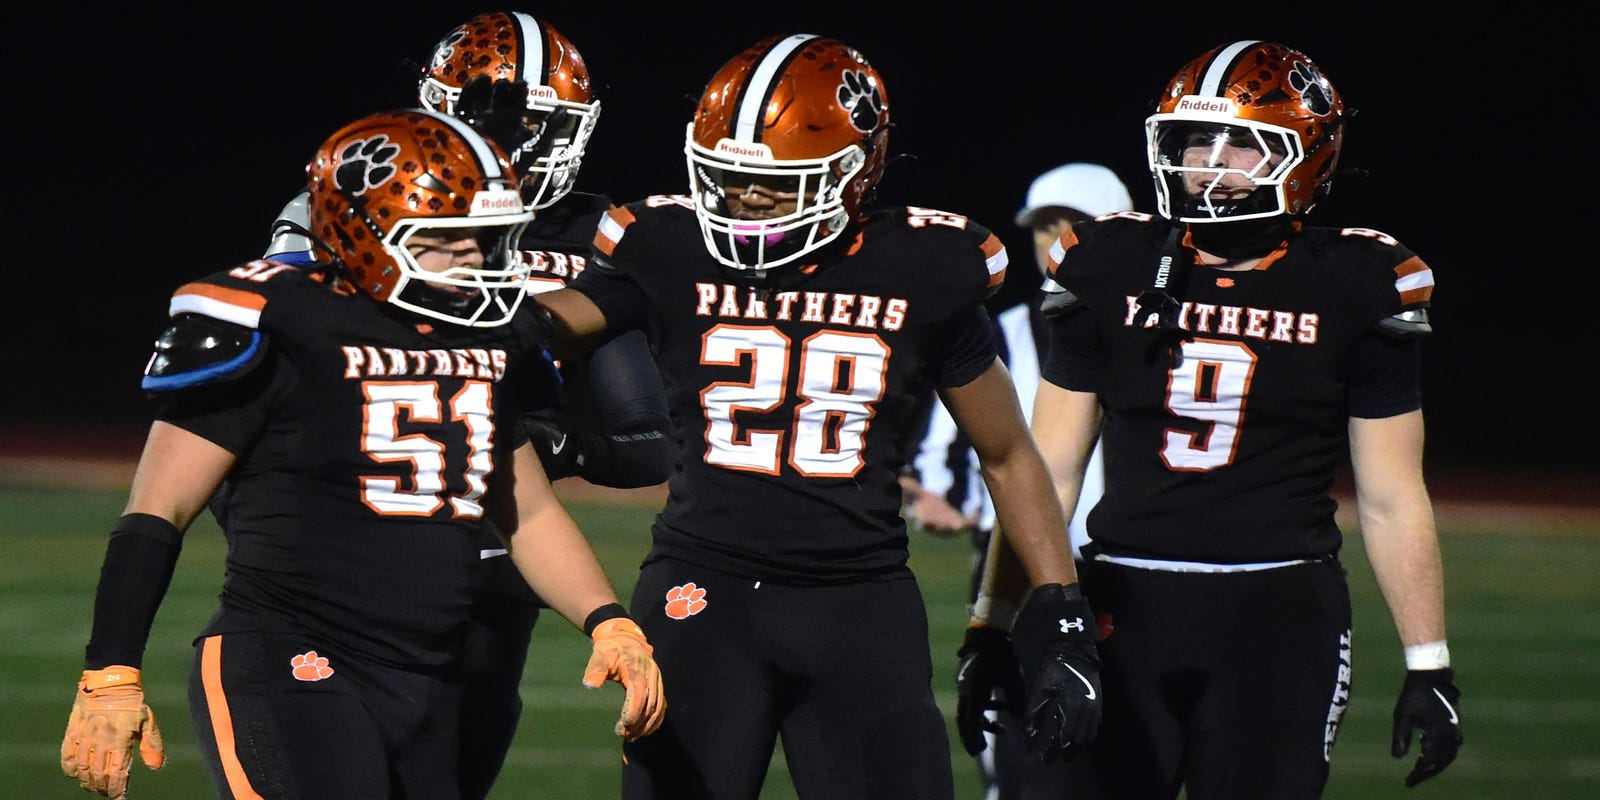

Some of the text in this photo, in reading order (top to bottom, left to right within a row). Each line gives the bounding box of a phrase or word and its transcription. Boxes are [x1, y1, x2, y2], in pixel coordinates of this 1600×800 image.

[526, 88, 553, 98] dell
[1180, 100, 1228, 112] Riddell
[1154, 256, 1173, 289] NXTRND
[696, 283, 908, 332] PANTHERS
[1124, 295, 1319, 345] PTHERS
[342, 345, 507, 383] PANTHERS
[699, 323, 892, 478] 28
[1159, 336, 1259, 473] 9
[359, 379, 496, 520] 51
